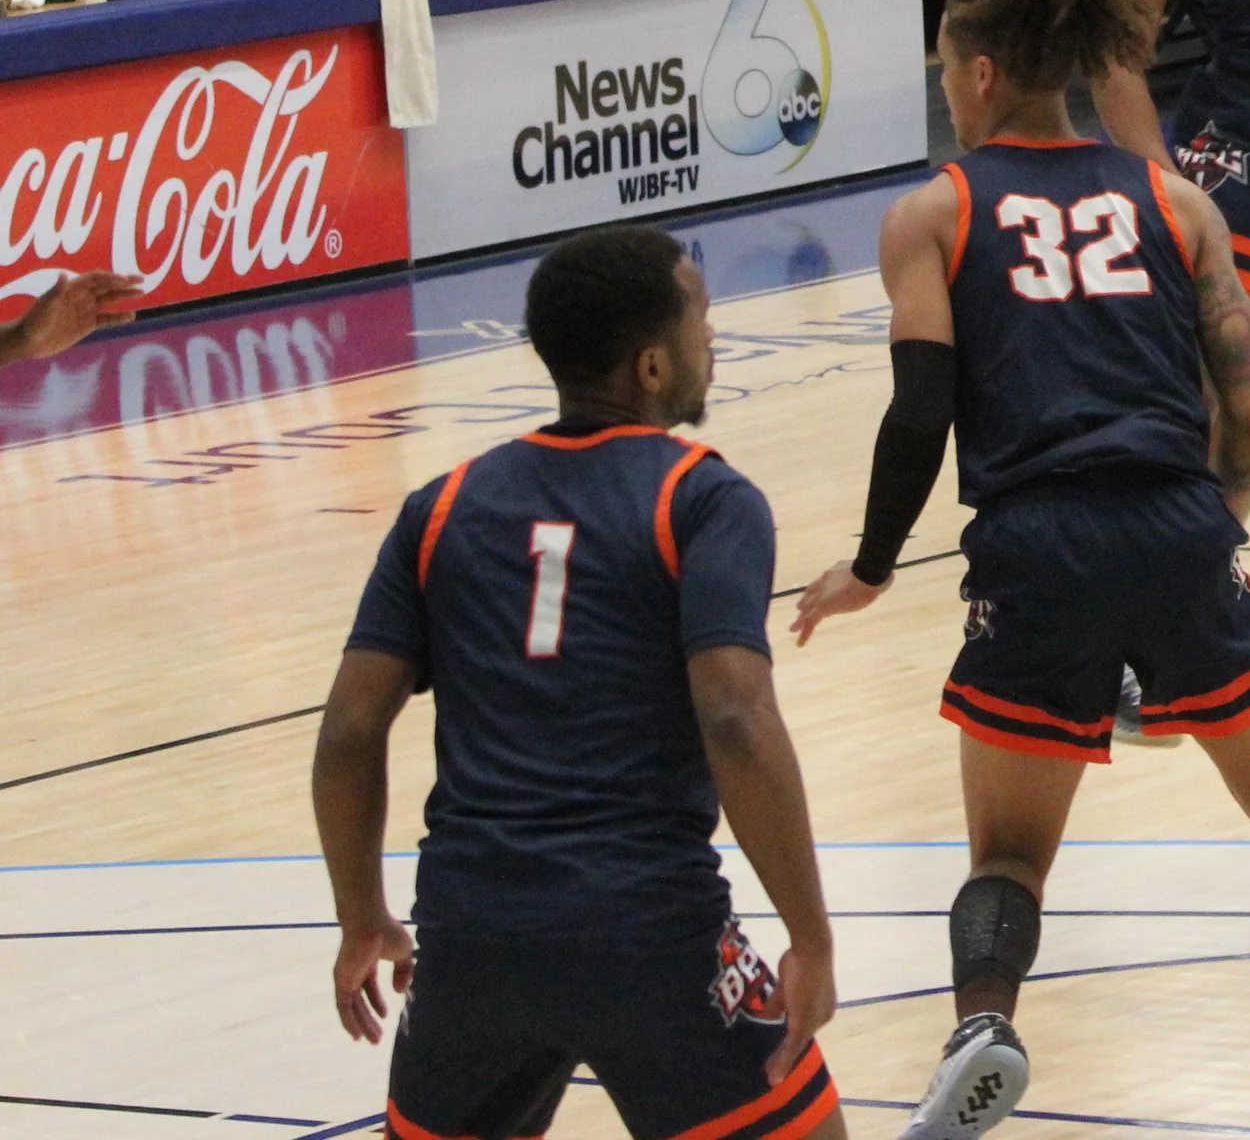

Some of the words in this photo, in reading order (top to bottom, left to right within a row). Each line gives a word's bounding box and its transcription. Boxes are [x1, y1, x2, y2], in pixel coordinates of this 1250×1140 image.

[555, 57, 686, 125] News
[778, 91, 822, 123] abc
[511, 94, 699, 189] Channel
[618, 164, 700, 206] WJBF-TV
[995, 191, 1153, 303] 32
[525, 520, 577, 659] 1
